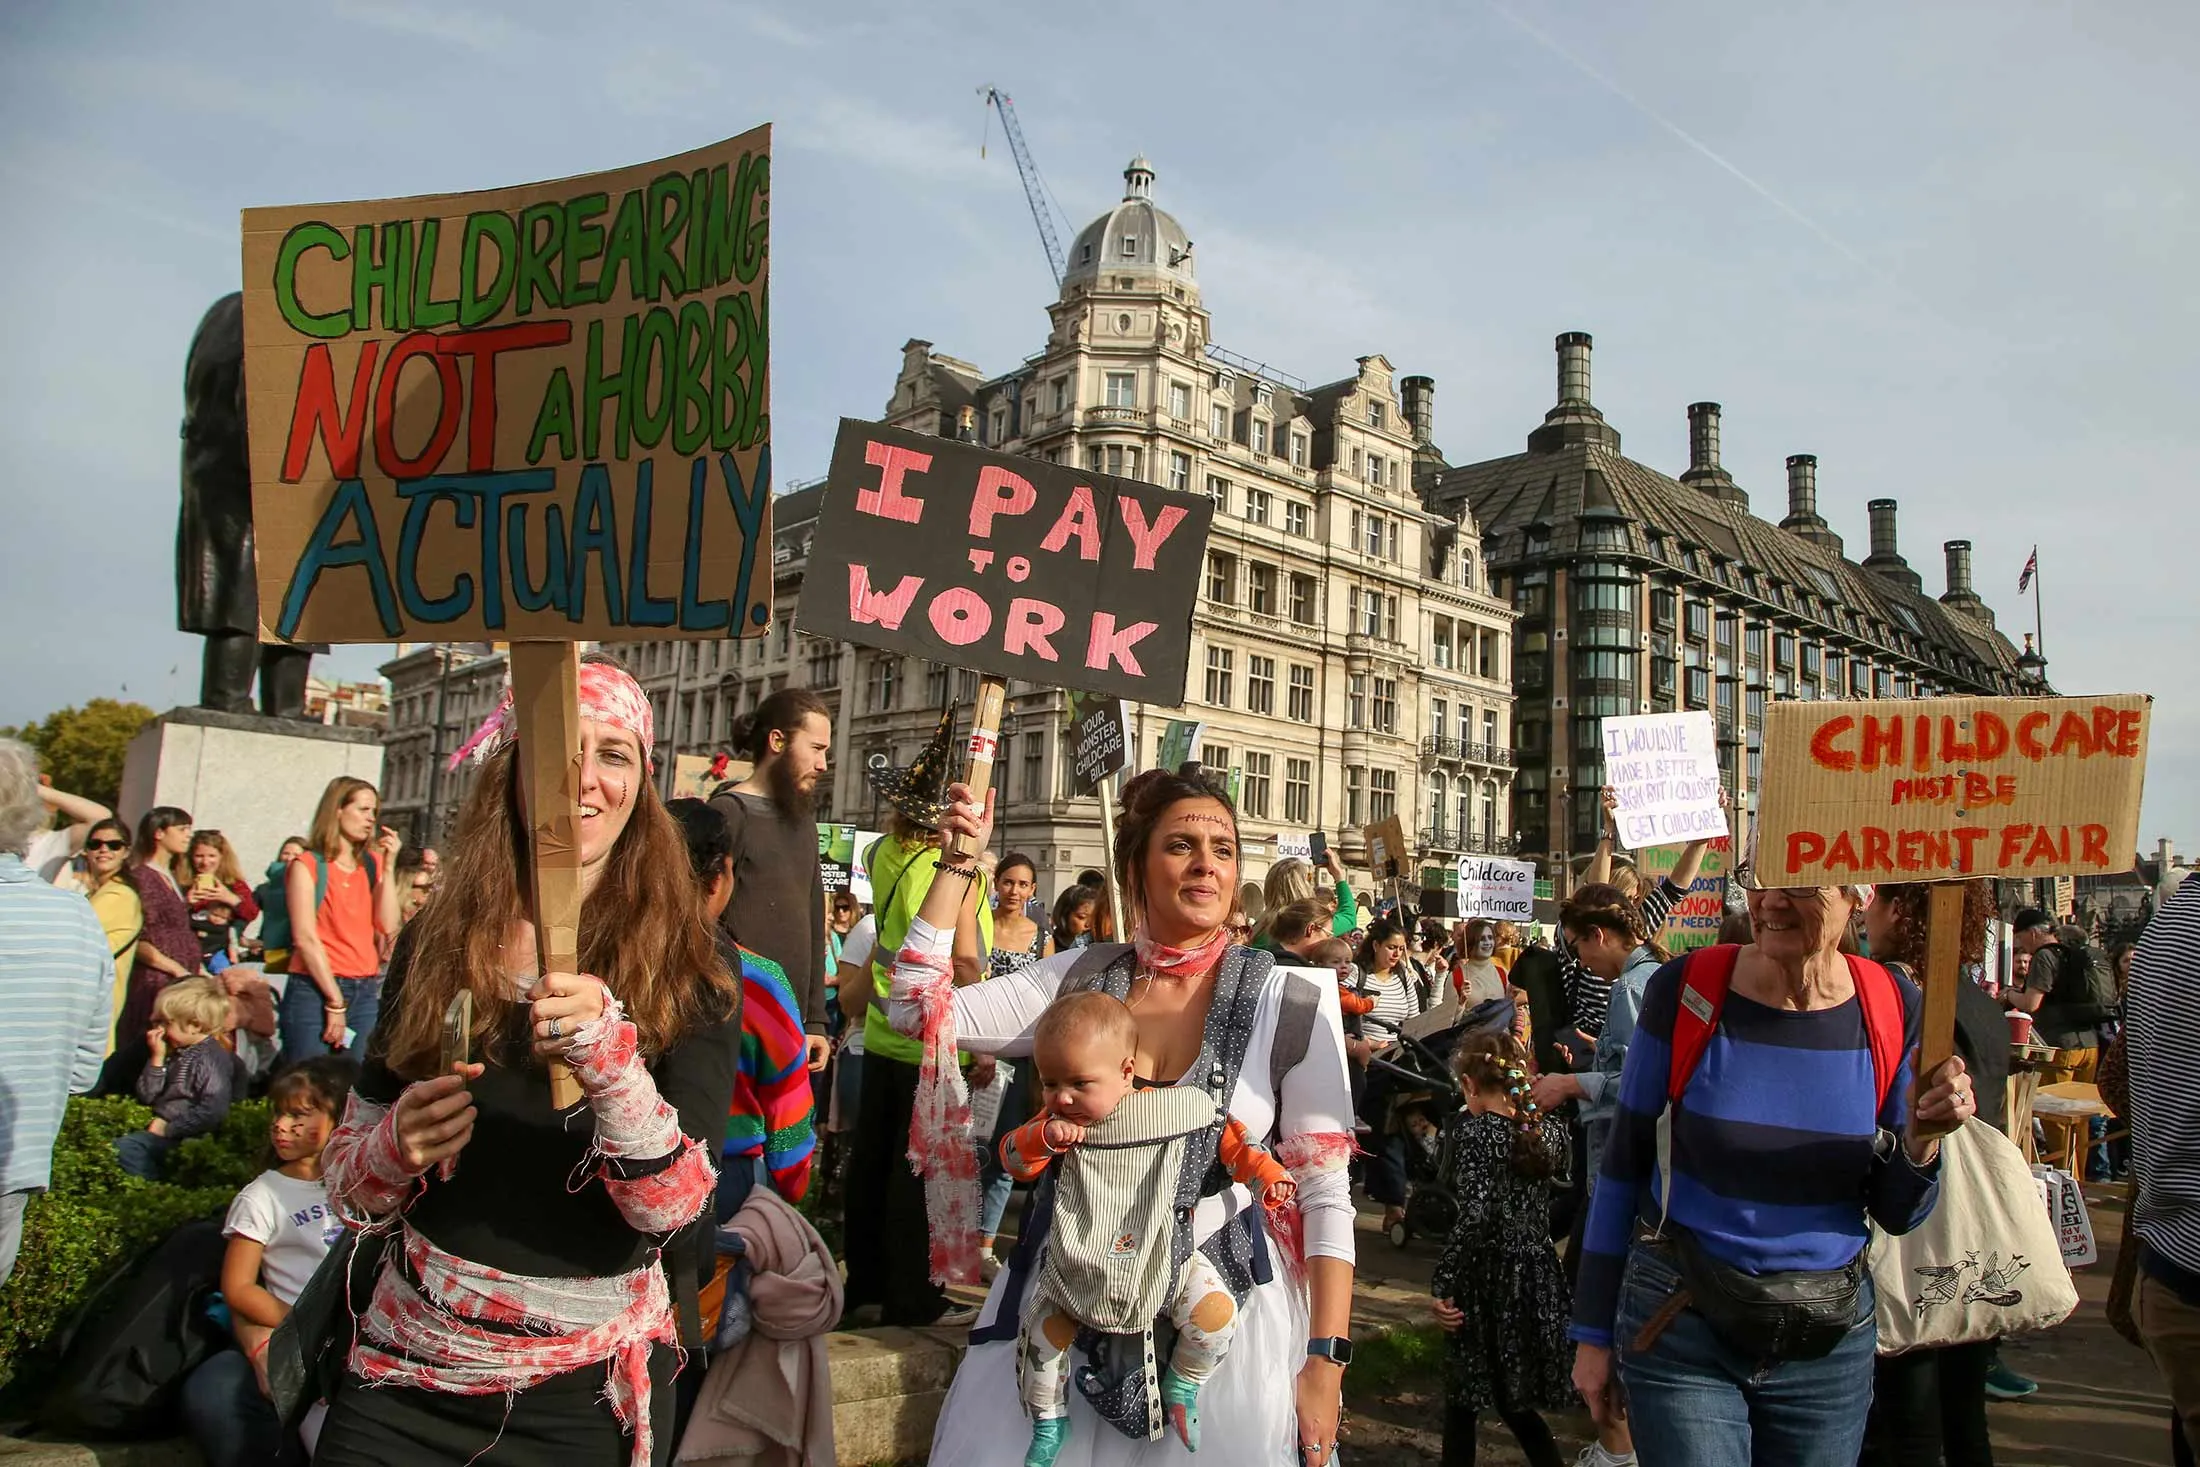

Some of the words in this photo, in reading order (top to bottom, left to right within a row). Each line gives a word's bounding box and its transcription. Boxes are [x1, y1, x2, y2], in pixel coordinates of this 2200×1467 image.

[280, 320, 571, 484] NOT
[526, 367, 576, 464] A
[583, 273, 769, 461] HOBBY,
[855, 440, 933, 524] I
[968, 465, 1189, 570] PAY
[276, 444, 771, 638] ACTUALLY.
[968, 548, 1030, 582] TO
[848, 563, 1159, 677] WORK
[1077, 721, 1116, 758] MONSTER
[1082, 710, 1105, 736] YOUR
[1809, 706, 2141, 772] CHILDCARE
[1076, 734, 1122, 776] CHILDCARE
[1607, 729, 1622, 756] I
[1090, 761, 1108, 782] BILL
[1610, 761, 1642, 784] MADE
[1656, 759, 1698, 778] BETTER
[1646, 781, 1667, 803] BUT
[1891, 774, 1958, 806] MUST
[1963, 771, 2017, 810] BE
[1627, 815, 1656, 841] GET
[1662, 808, 1721, 836] CHILDCARE
[1278, 845, 1310, 856] CHILDCA
[1786, 826, 1989, 874] PARENT
[1998, 823, 2110, 869] FAIR
[822, 878, 849, 886] DCARE
[1461, 859, 1526, 882] Childcare
